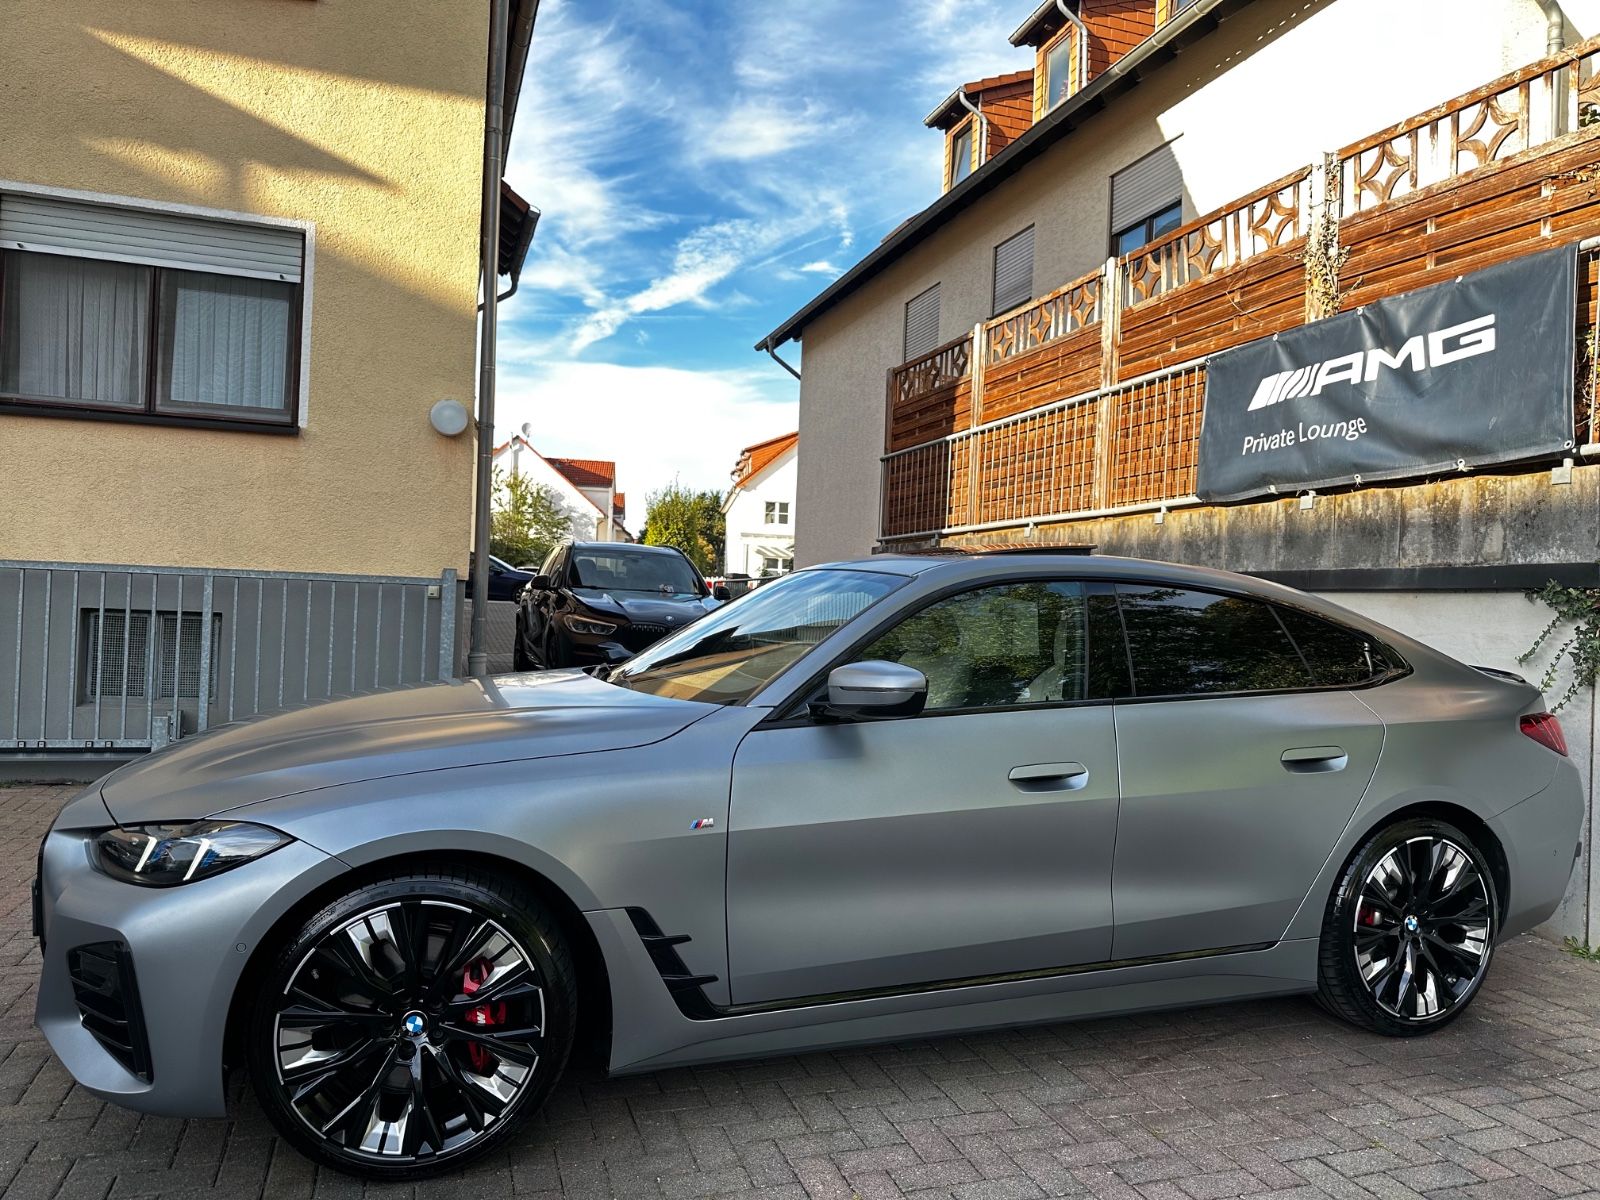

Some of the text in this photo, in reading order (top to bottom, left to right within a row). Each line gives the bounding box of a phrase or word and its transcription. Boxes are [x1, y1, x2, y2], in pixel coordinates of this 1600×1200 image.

[1310, 313, 1496, 396] AMG
[1242, 417, 1367, 455] Private Lounge
